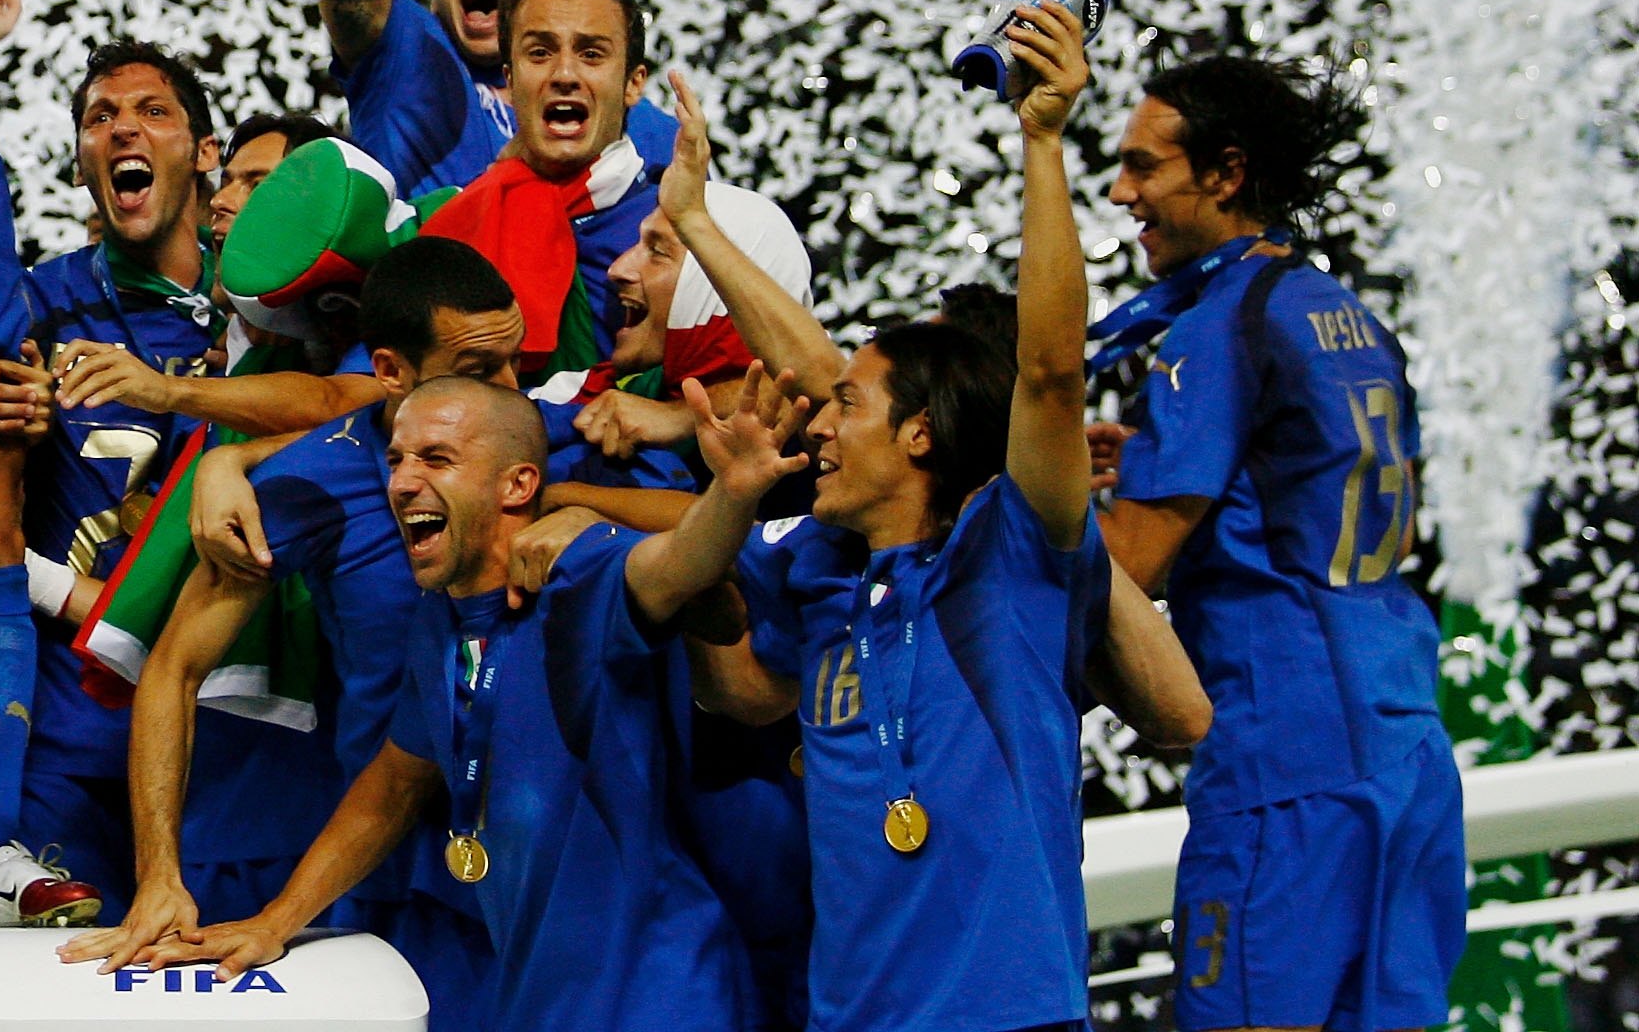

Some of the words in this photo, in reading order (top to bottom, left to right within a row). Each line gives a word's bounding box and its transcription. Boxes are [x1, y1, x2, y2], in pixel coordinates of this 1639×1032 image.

[1328, 378, 1406, 587] 13
[905, 621, 914, 644] FIFA
[860, 637, 870, 659] FIFA
[483, 667, 496, 689] FIFA
[814, 642, 862, 727] 16
[878, 723, 889, 746] FIFA
[897, 718, 905, 740] FIFA
[467, 759, 478, 781] FIFA
[115, 969, 287, 994] FIFA
